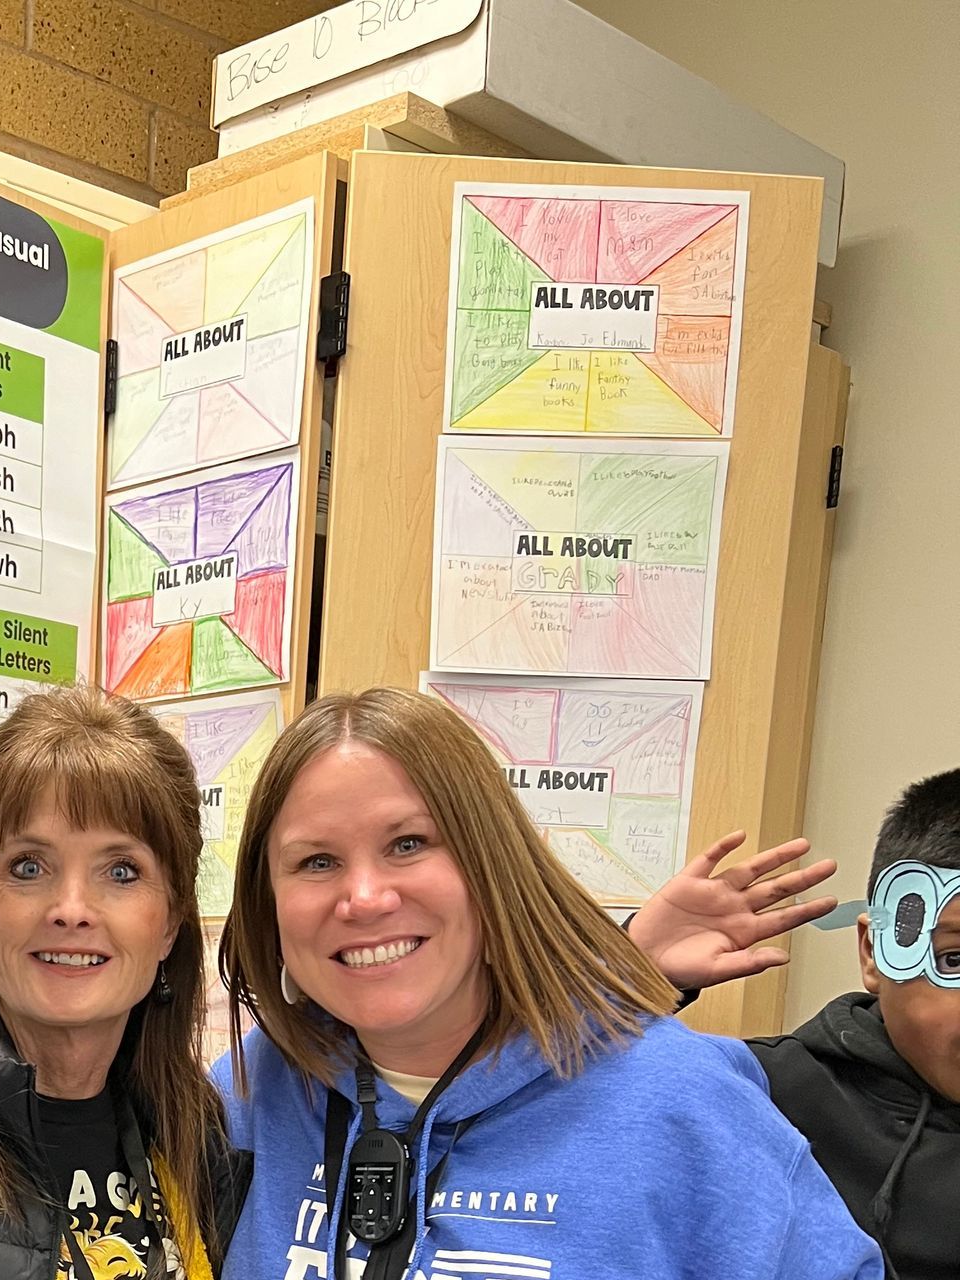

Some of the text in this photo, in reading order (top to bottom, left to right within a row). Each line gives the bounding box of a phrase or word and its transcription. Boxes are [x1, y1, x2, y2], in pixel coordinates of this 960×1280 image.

[535, 286, 655, 312] ALL ABOUT
[164, 318, 245, 362] ALL ABOUT
[517, 534, 554, 556] ALL
[560, 536, 633, 560] ABOUT
[157, 556, 234, 591] ALL ABOUT
[3, 619, 49, 647] Silent
[503, 768, 609, 793] LL ABOUT
[68, 1169, 97, 1210] A
[430, 1191, 559, 1214] MENTARY
